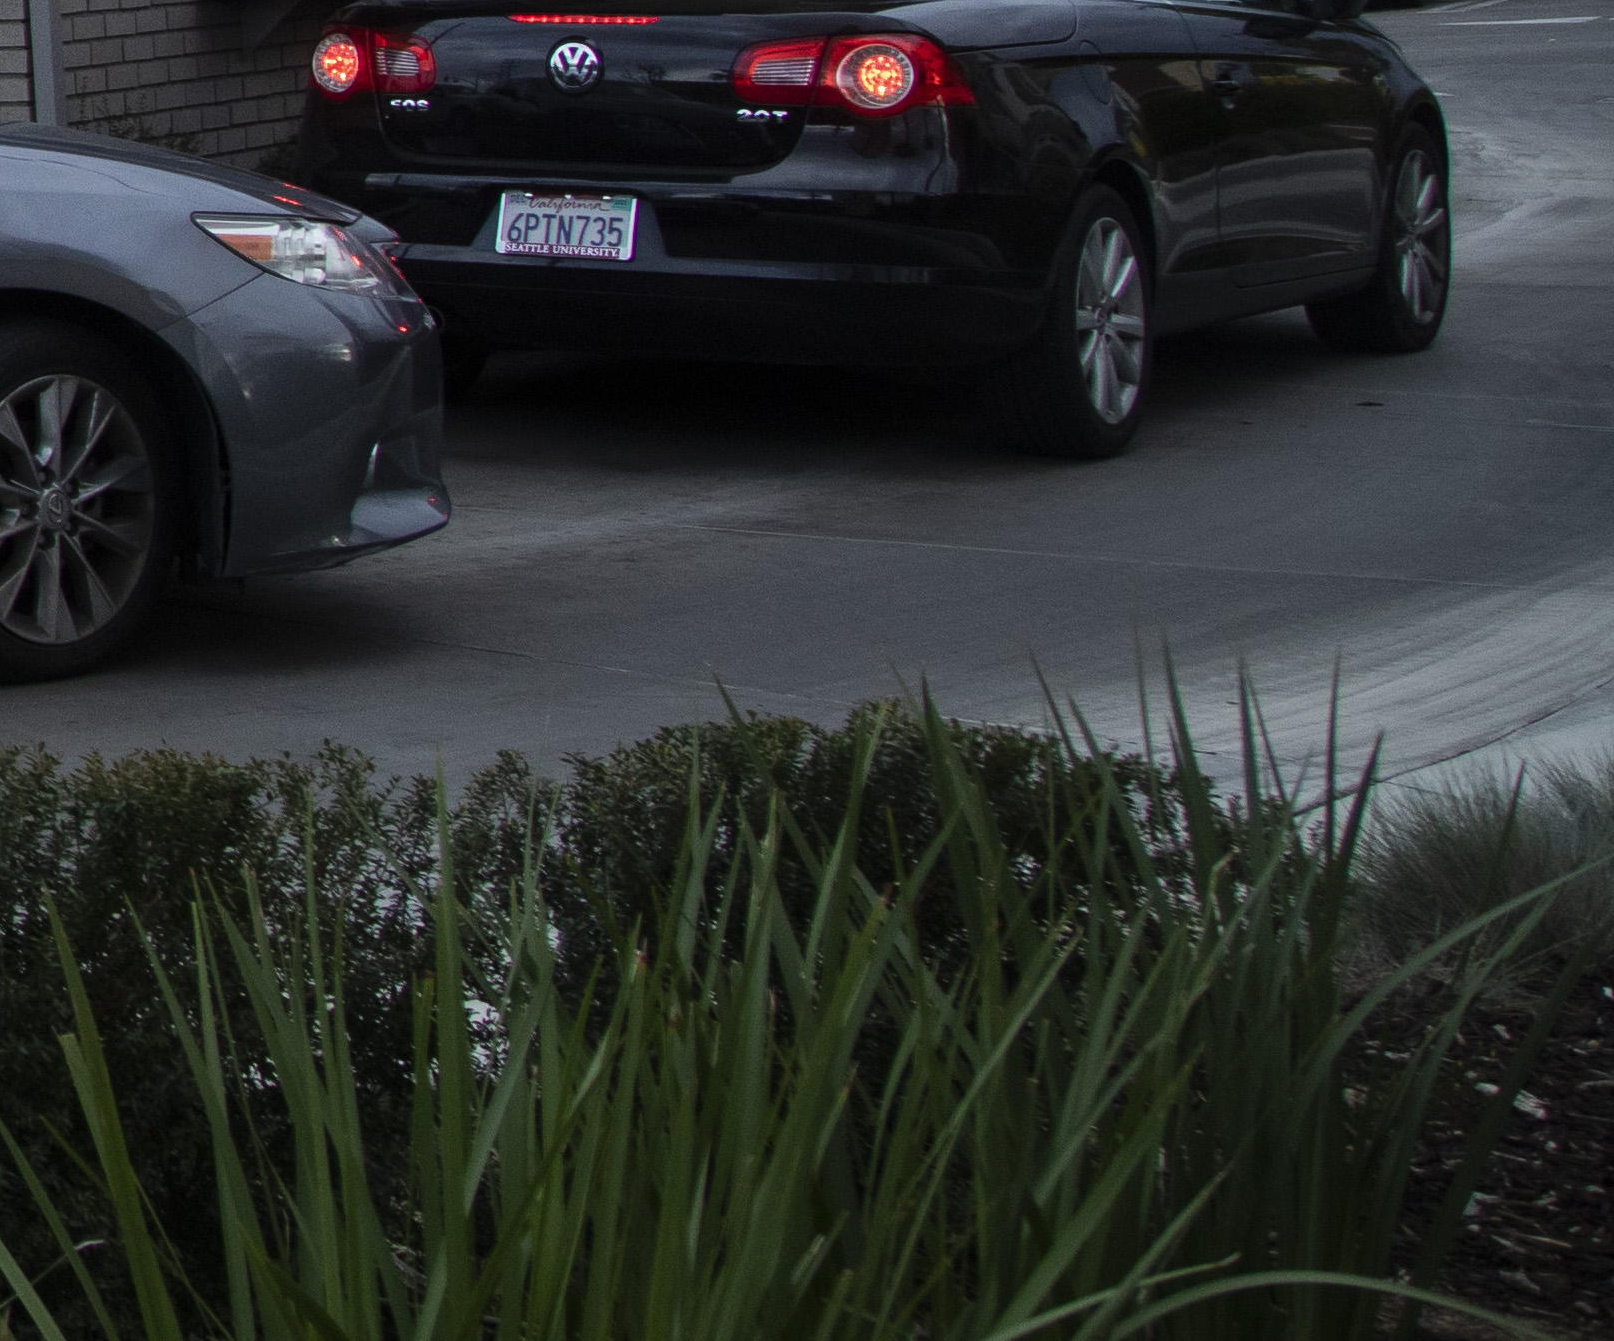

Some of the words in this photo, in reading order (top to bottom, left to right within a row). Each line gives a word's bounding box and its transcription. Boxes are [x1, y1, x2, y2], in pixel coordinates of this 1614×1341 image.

[528, 197, 610, 214] California
[507, 212, 624, 247] 6PTN735
[505, 243, 549, 254] SEATTLE
